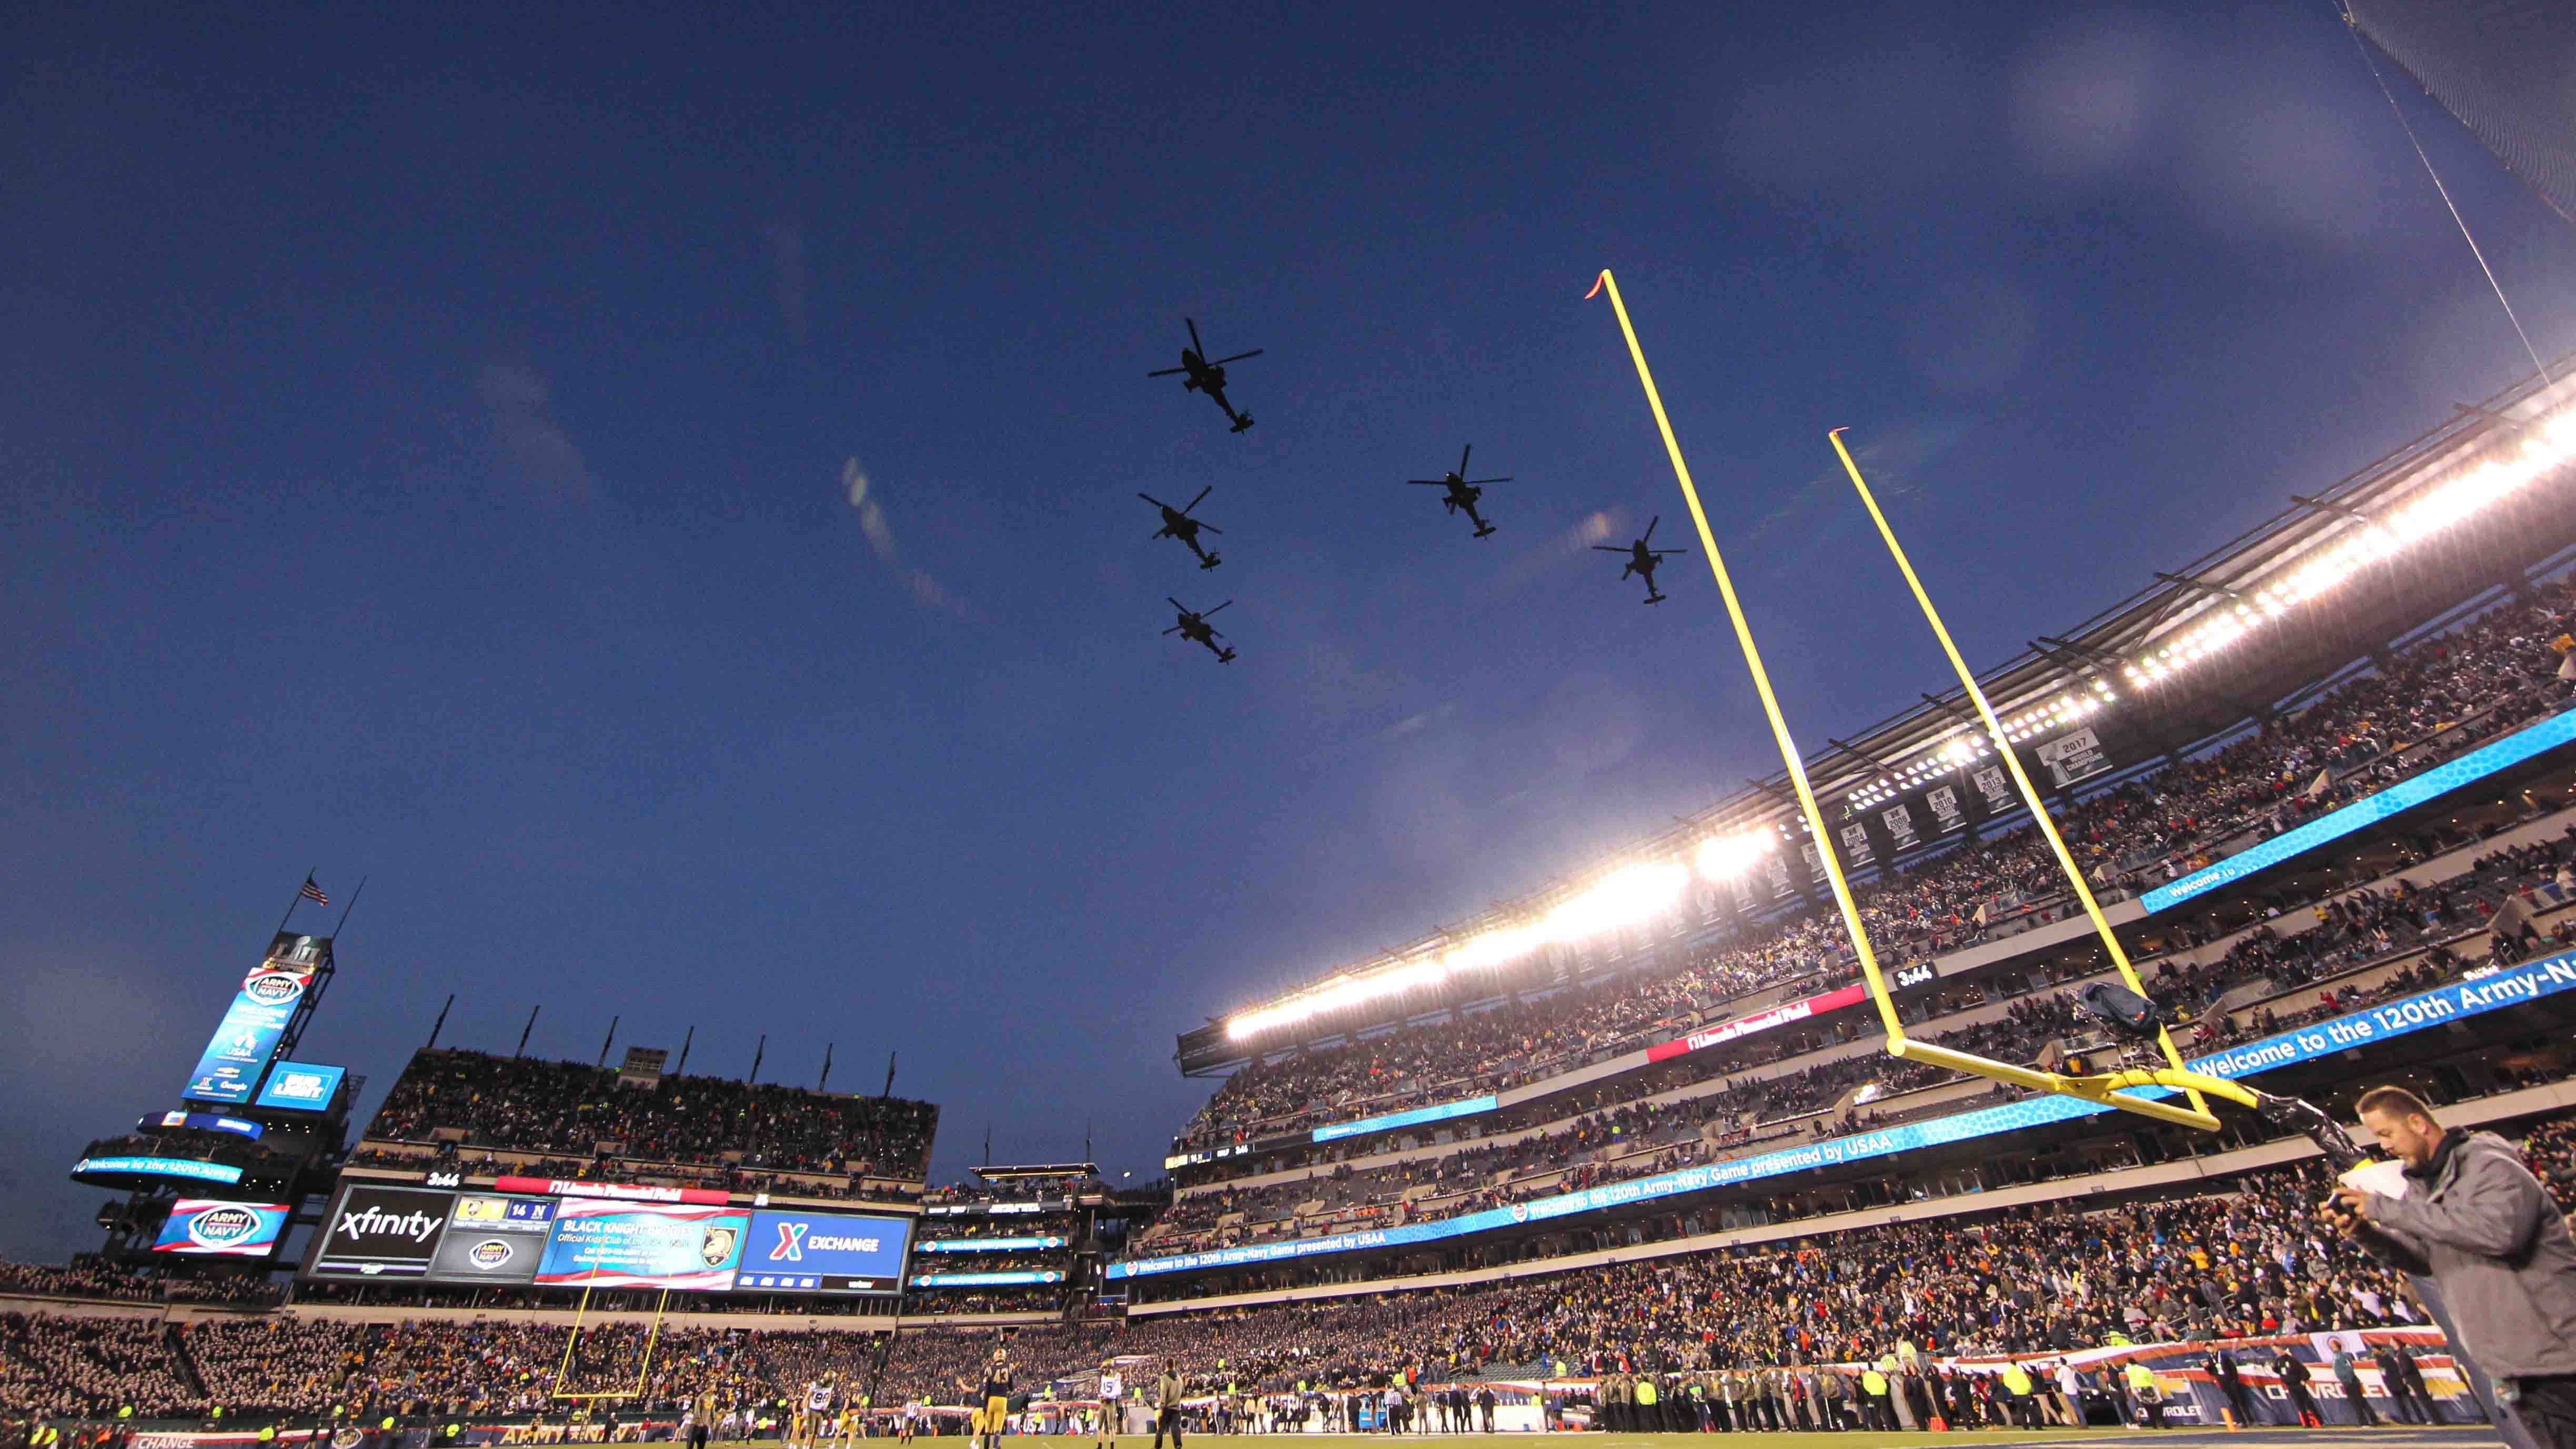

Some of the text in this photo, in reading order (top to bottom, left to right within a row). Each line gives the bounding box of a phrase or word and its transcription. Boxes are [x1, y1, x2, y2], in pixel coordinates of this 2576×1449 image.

[2062, 737, 2087, 753] 2017
[2066, 752, 2104, 771] CHAMPIONS
[2069, 749, 2094, 763] WORLD
[1981, 777, 2002, 791] 2013
[1934, 796, 1953, 809] 2010
[2168, 871, 2220, 898] Welcome
[260, 978, 293, 988] ARMY
[1897, 964, 1933, 987] 3:44
[257, 987, 289, 998] NAVY
[2192, 1040, 2296, 1078] Welcome
[2297, 1034, 2326, 1052] to
[2328, 1018, 2373, 1044] the
[2373, 996, 2456, 1030] 120th
[273, 1083, 324, 1098] LIGHT
[88, 1160, 130, 1169] Welcome
[132, 1160, 144, 1169] to
[146, 1161, 165, 1170] the
[427, 1172, 460, 1186] 3:44
[1530, 1134, 1895, 1216] Welcome to the 120th Army-Navy Game presented by USAA
[208, 1212, 248, 1223] ARMY
[512, 1204, 527, 1217] 14
[203, 1226, 241, 1237] NAVY
[336, 1205, 444, 1243] xfinity
[562, 1220, 602, 1233] BLACK
[603, 1221, 644, 1235] KNIGHT
[558, 1233, 585, 1242] Official
[605, 1235, 622, 1244] Club
[769, 1222, 809, 1261] X
[808, 1236, 880, 1252] EXCHANGE
[1140, 1232, 1386, 1272] Welcome to the 120th Army-Navy Game presented by USAA
[993, 1368, 1009, 1384] 43
[2265, 1382, 2393, 1400] CHVROET
[2137, 1405, 2202, 1417] CVROLET
